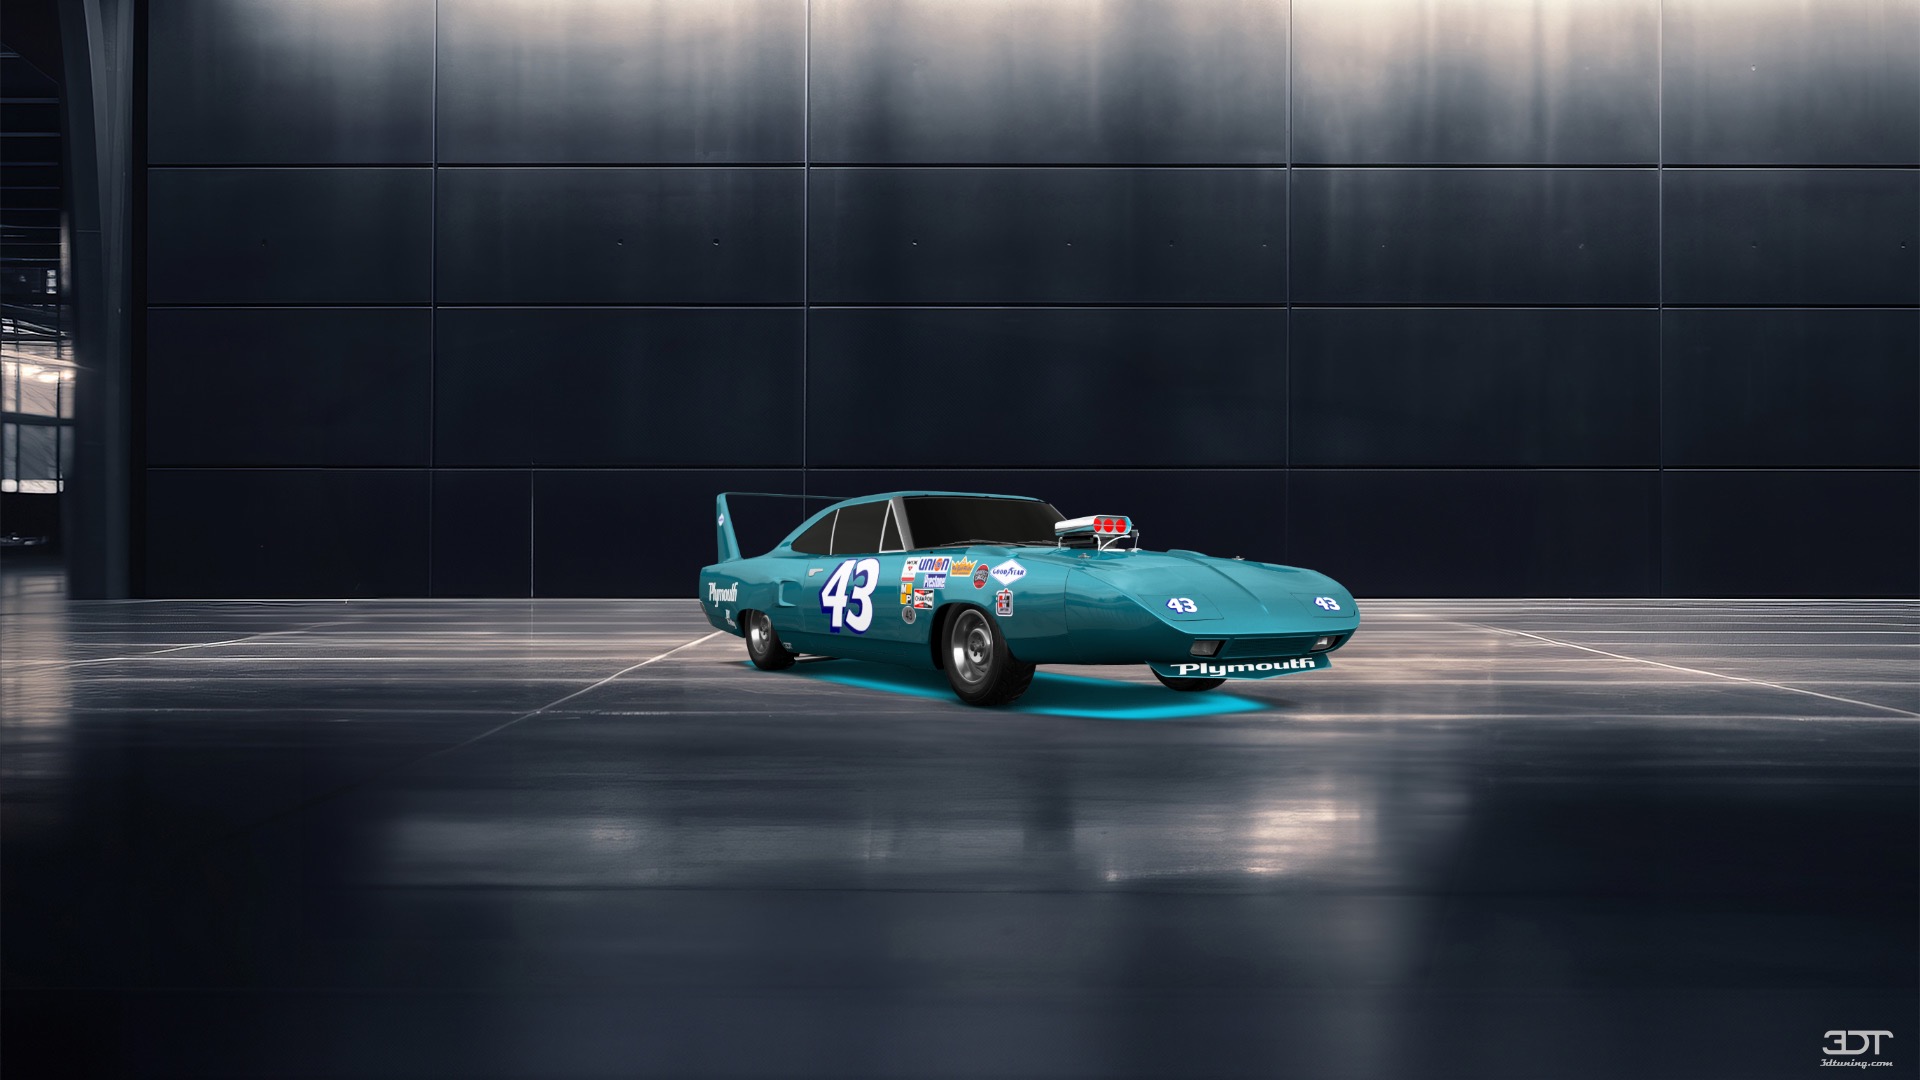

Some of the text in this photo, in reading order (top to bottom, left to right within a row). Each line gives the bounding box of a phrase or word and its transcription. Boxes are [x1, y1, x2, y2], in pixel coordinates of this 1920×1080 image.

[819, 558, 880, 634] 43
[1314, 596, 1341, 611] 43
[1166, 597, 1197, 614] 43
[1170, 657, 1316, 677] Plymouth
